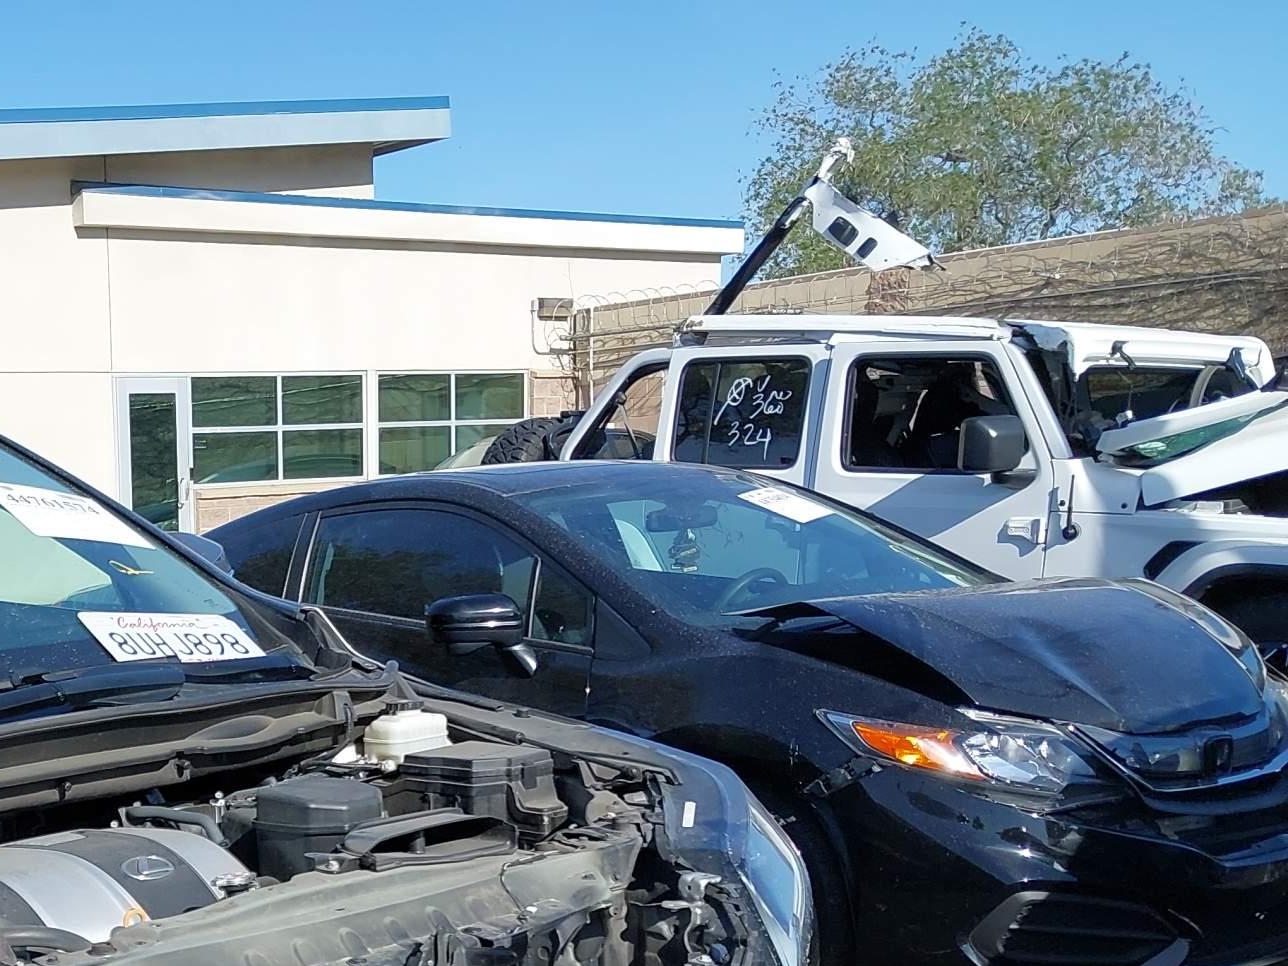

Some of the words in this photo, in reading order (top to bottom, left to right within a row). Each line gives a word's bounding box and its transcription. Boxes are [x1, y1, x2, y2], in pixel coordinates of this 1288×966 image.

[727, 421, 772, 461] 324
[6, 493, 100, 516] 44761574
[116, 616, 200, 633] California
